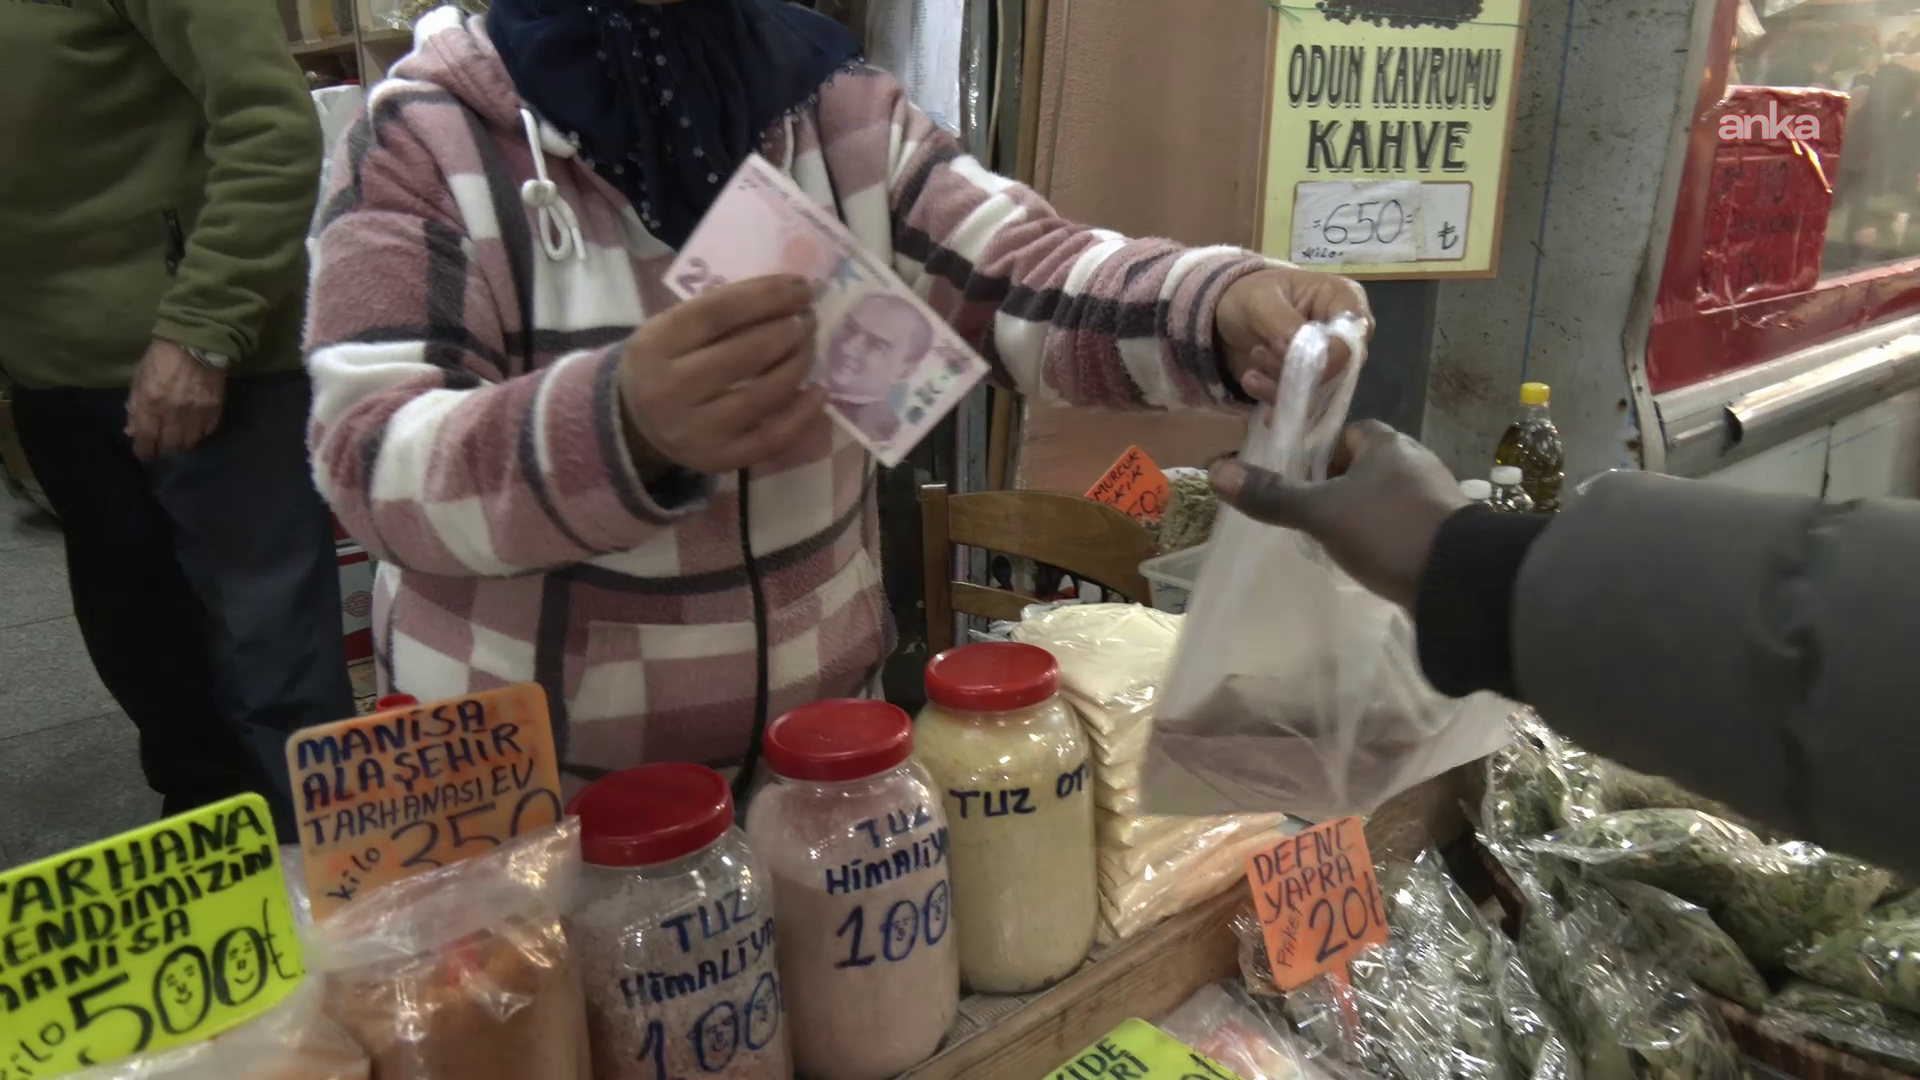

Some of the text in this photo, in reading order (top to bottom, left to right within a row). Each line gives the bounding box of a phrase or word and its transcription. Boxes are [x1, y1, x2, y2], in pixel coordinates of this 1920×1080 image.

[1288, 44, 1502, 110] ODUN KAVRUMU
[1306, 119, 1472, 173] KAHVE
[297, 699, 485, 772] MANİSA
[855, 804, 932, 849] TUZ
[949, 787, 1037, 819] TUZ
[660, 888, 757, 953] TUZ
[833, 879, 950, 969] 100
